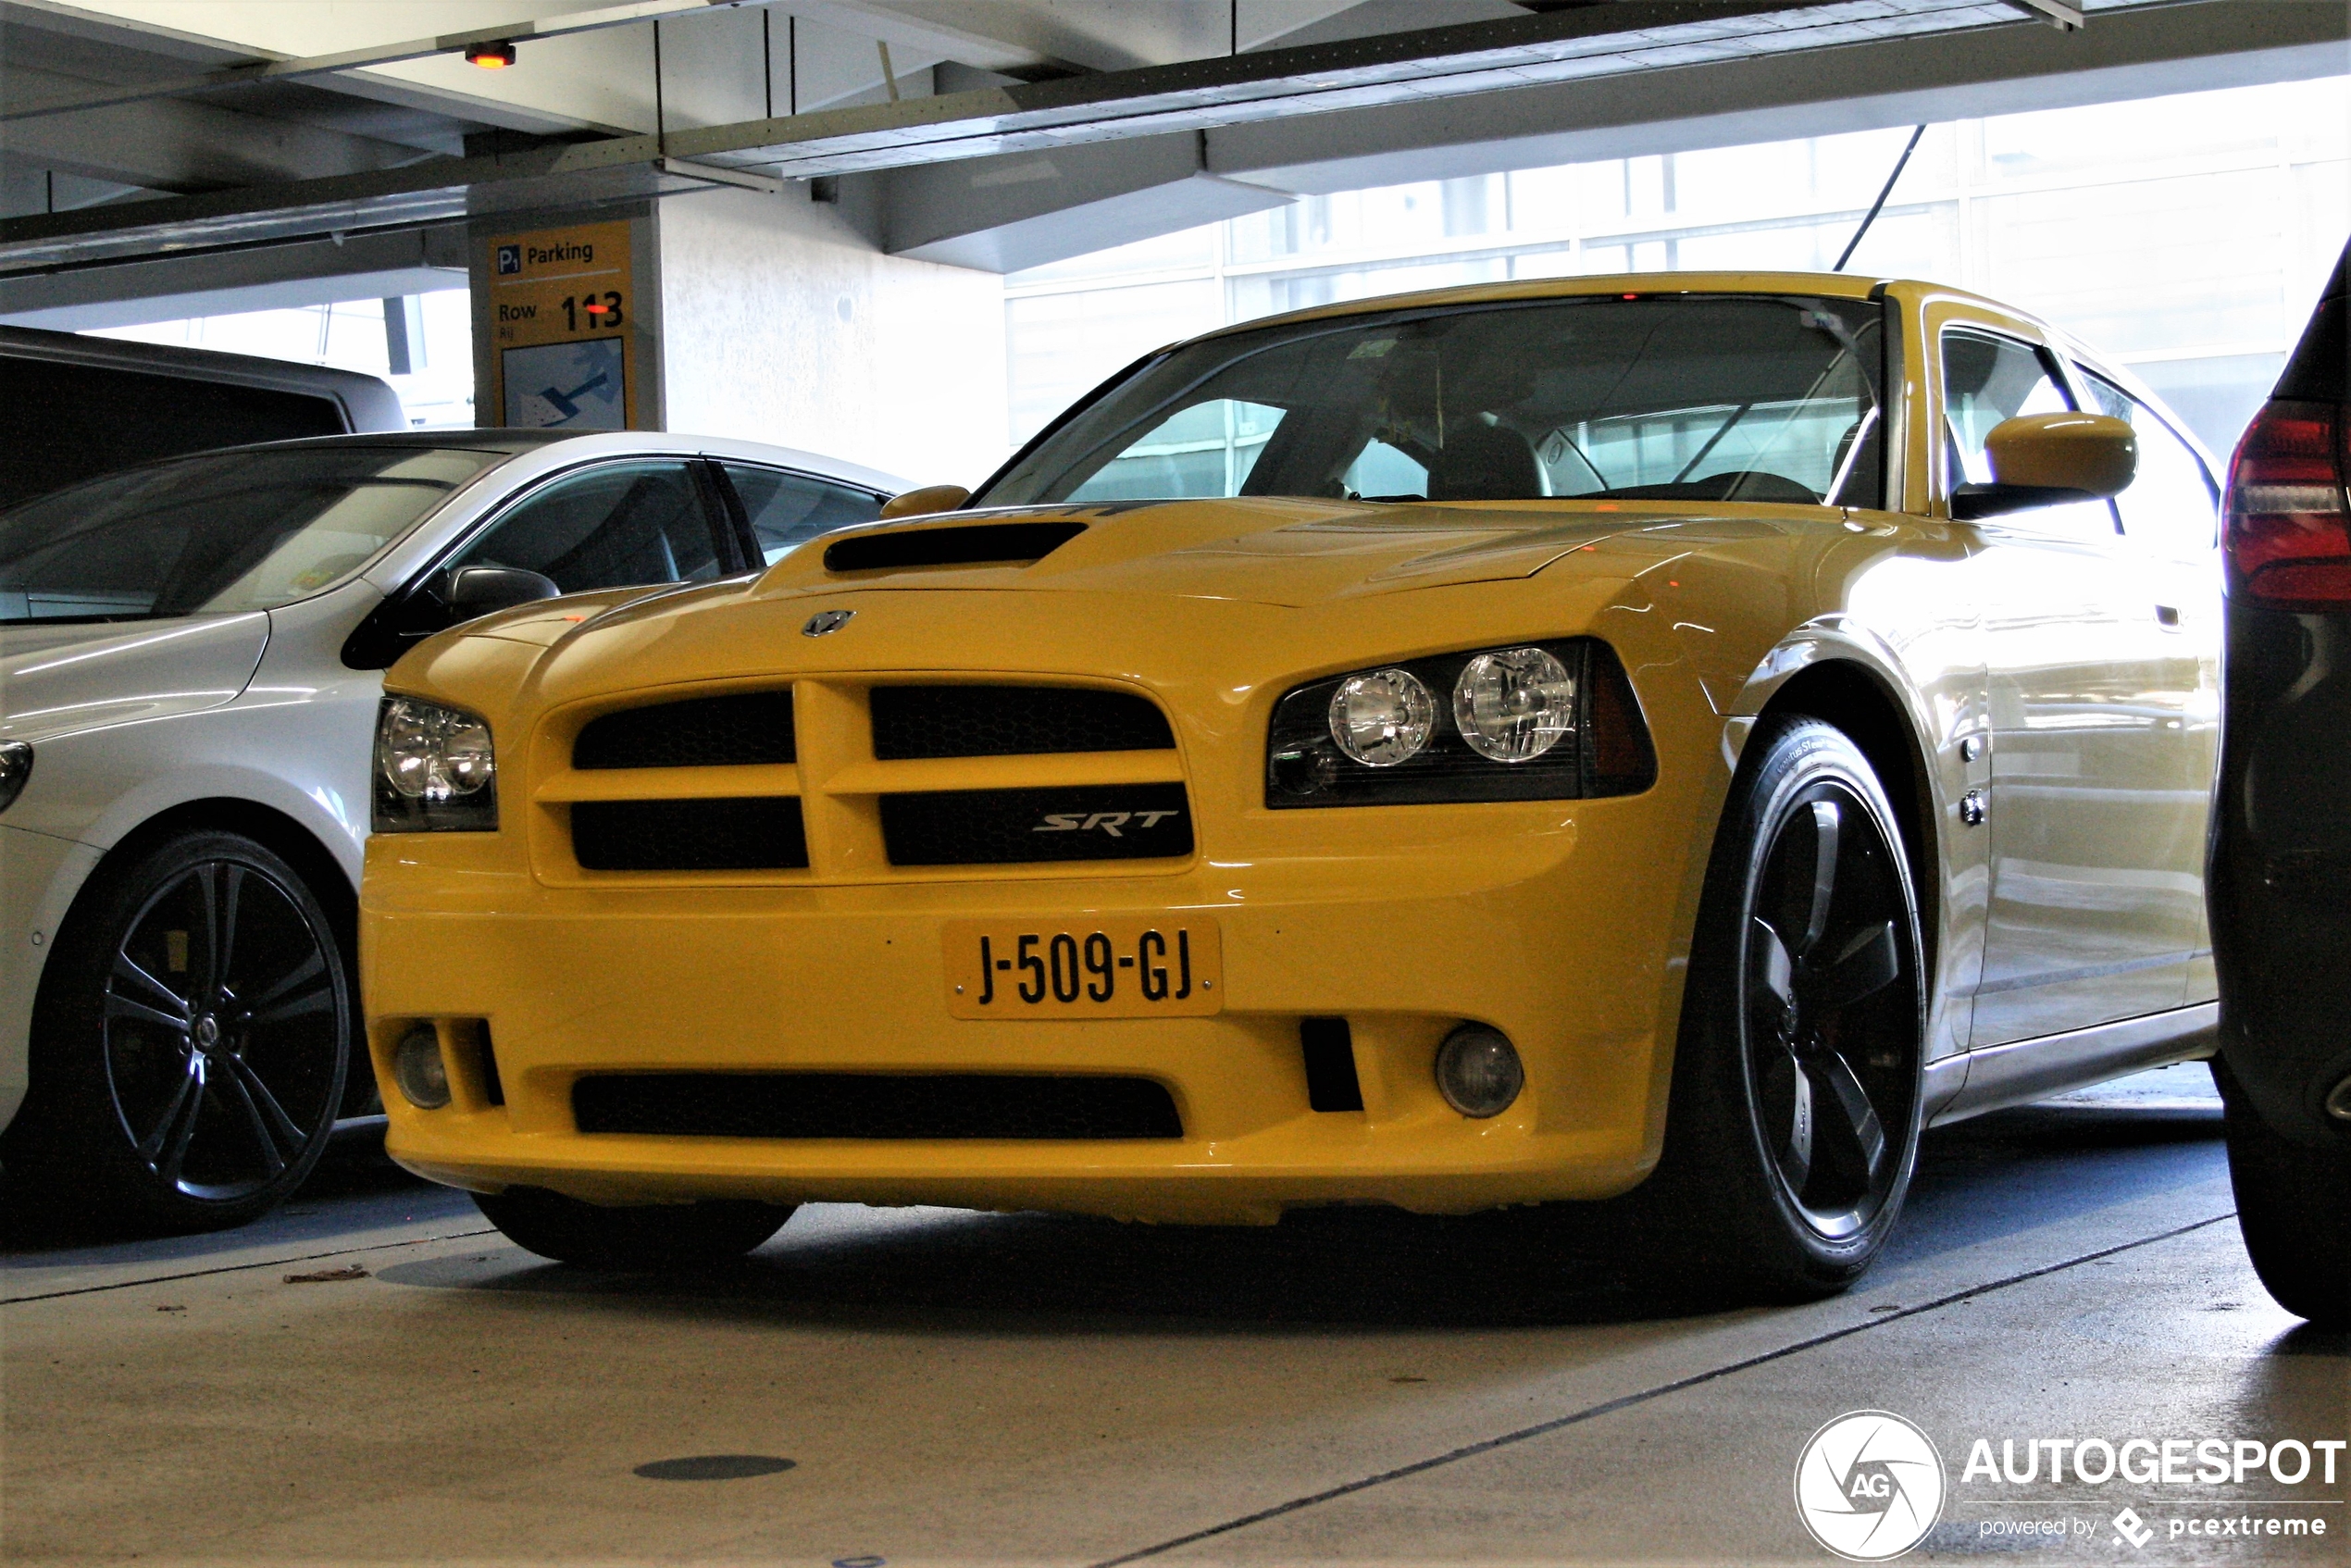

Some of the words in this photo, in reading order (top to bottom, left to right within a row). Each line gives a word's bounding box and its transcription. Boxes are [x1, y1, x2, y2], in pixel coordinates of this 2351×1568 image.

[528, 242, 593, 265] Parking
[499, 305, 537, 322] Row
[561, 291, 624, 331] 113
[1032, 810, 1179, 838] SRT
[978, 928, 1191, 1005] J-509-GJ
